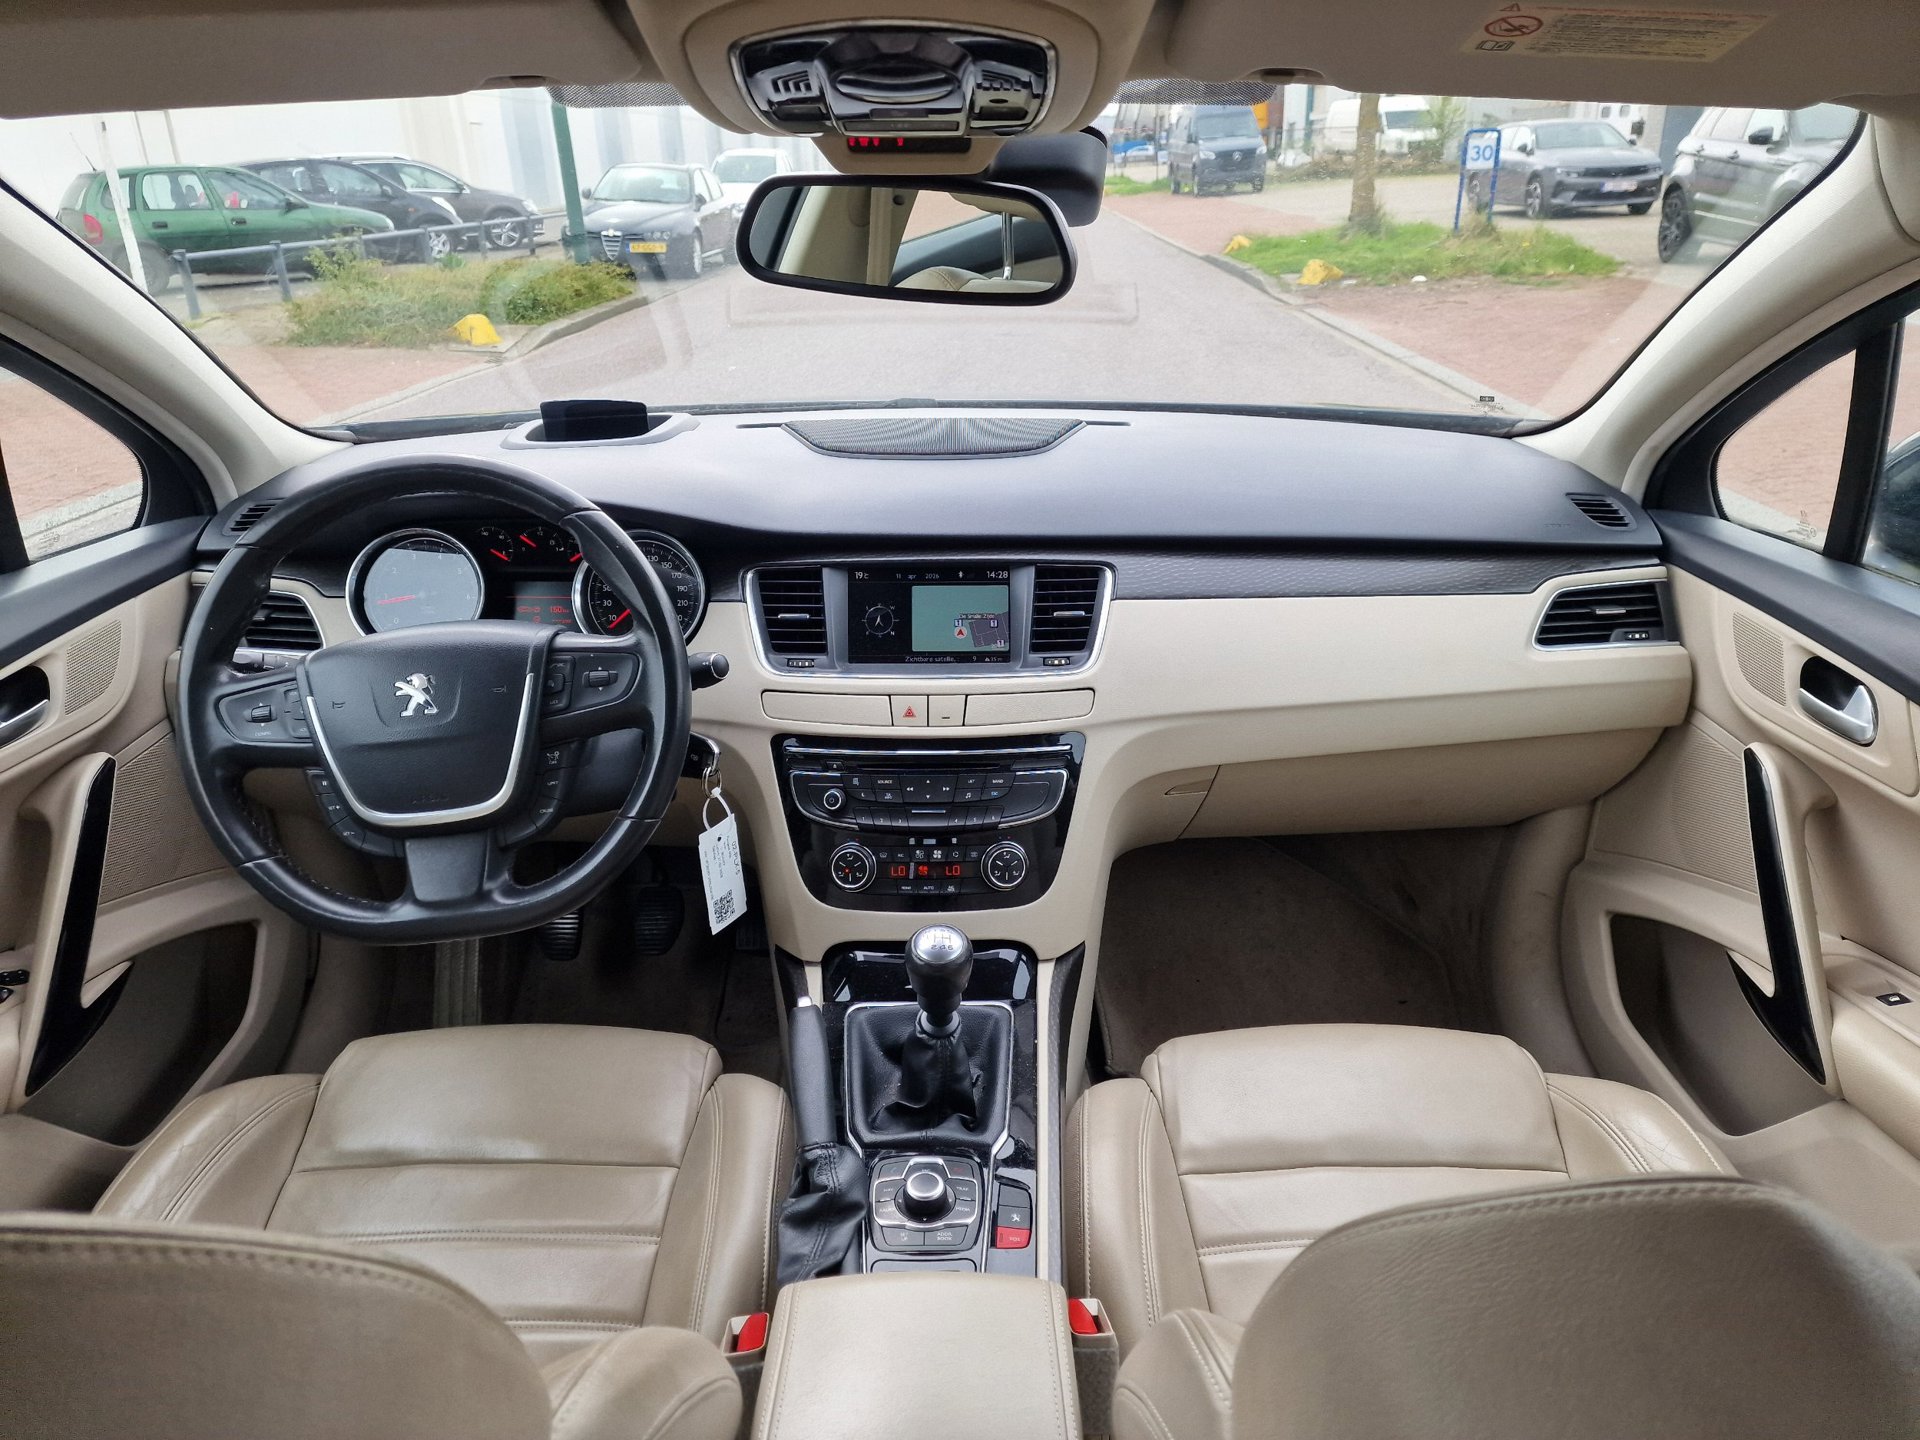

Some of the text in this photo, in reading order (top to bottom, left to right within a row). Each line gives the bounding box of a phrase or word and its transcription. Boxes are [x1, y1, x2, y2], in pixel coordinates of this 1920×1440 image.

[1470, 144, 1493, 161] 30
[661, 561, 673, 569] 150
[986, 570, 1009, 579] 14:28
[891, 865, 906, 876] LO
[945, 865, 960, 876] LO
